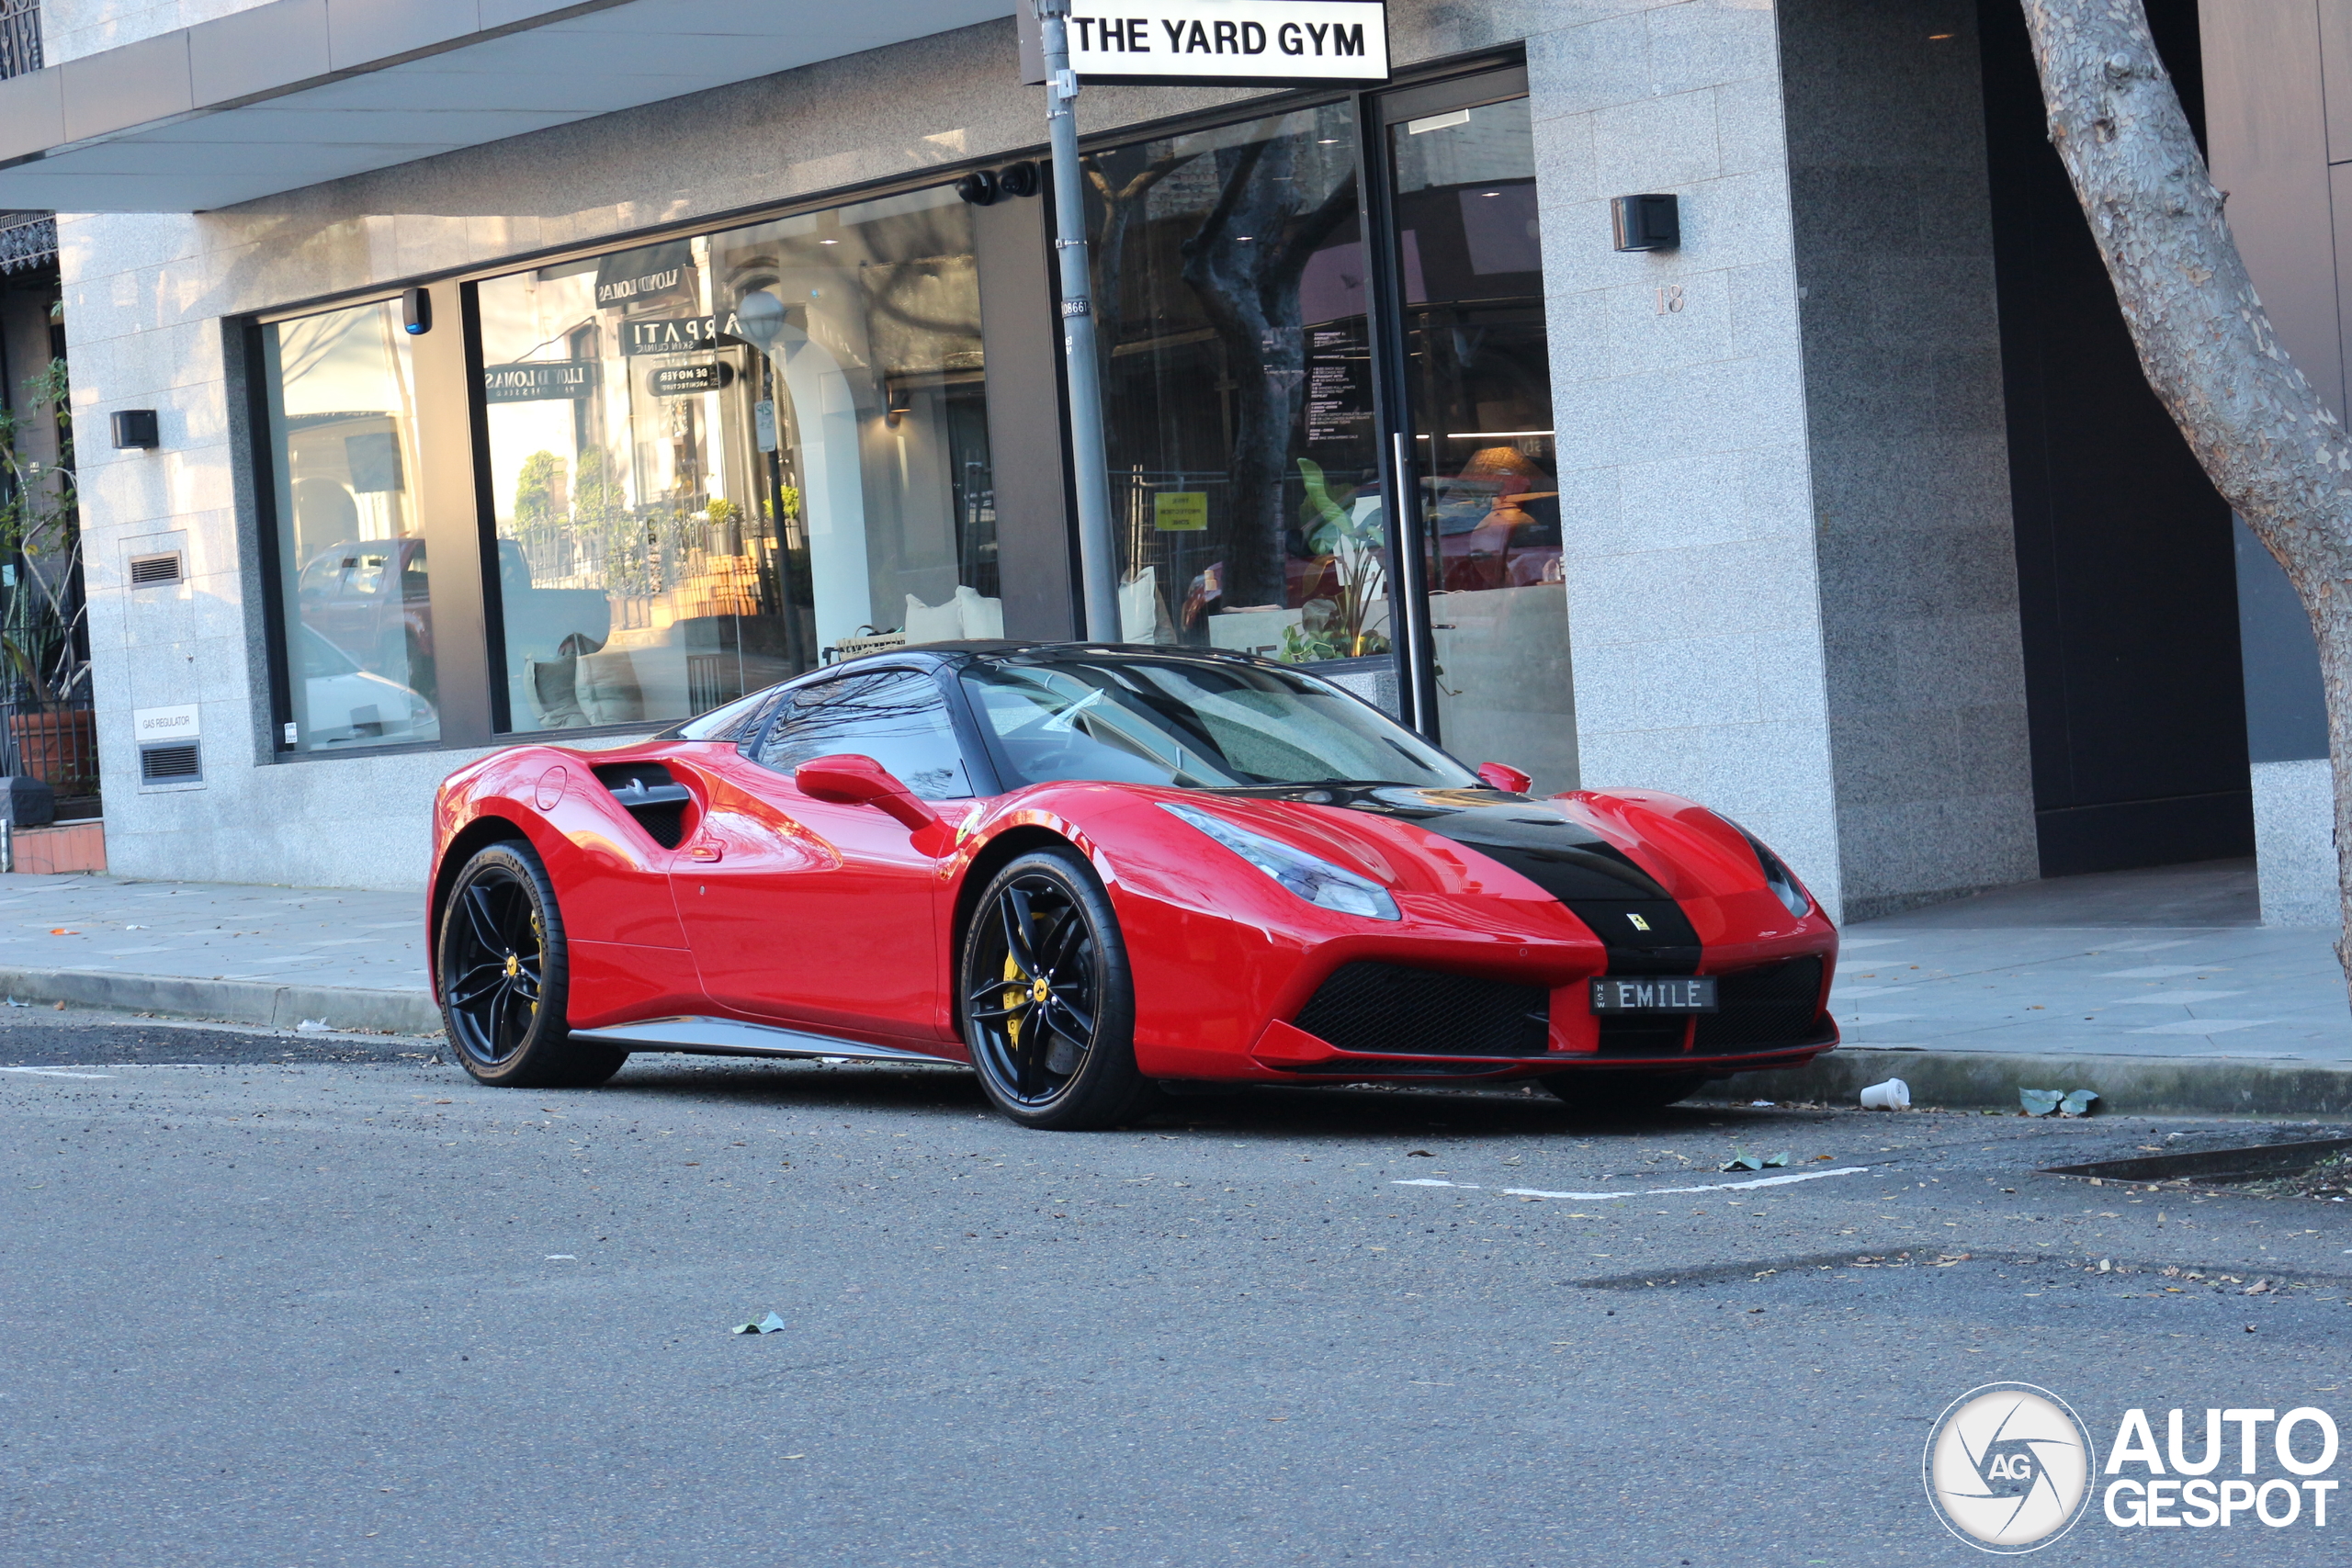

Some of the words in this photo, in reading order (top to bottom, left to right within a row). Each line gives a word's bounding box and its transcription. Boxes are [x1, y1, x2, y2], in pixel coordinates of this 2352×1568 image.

[1073, 17, 1150, 52] THE
[1161, 19, 1267, 55] YARD
[1278, 22, 1365, 57] GYM
[1654, 285, 1684, 315] 18
[143, 718, 154, 729] GAS
[155, 716, 190, 728] REGULATOR
[1596, 984, 1606, 1009] NSW
[1619, 984, 1702, 1008] EMILE
